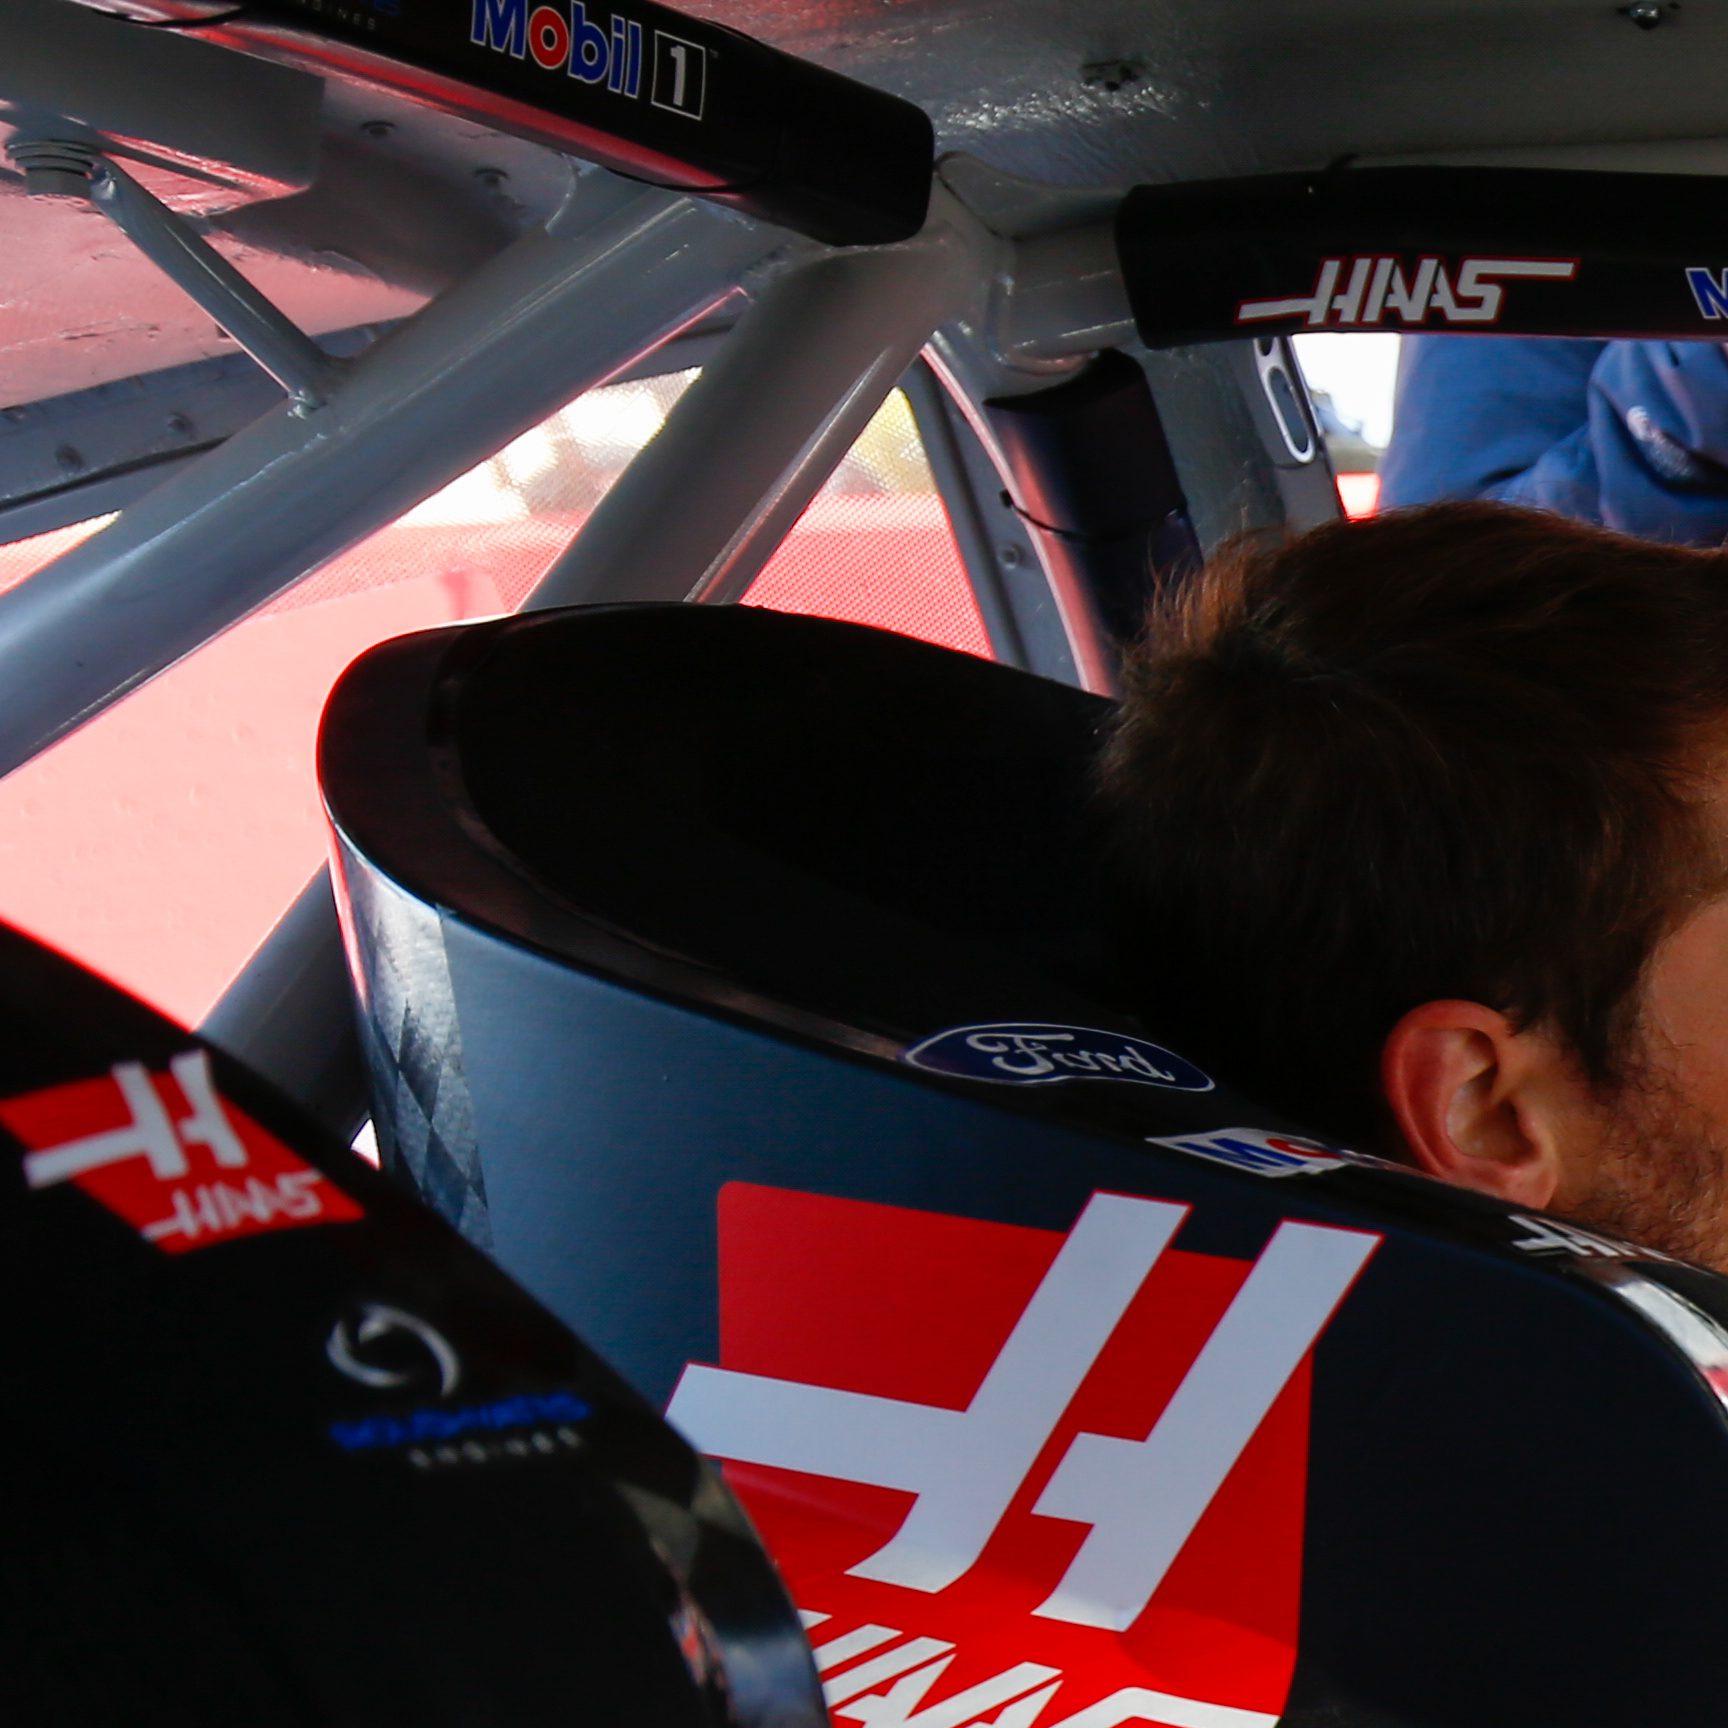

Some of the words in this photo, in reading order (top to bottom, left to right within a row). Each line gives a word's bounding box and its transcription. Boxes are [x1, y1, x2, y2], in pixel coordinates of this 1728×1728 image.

[470, 0, 642, 99] Mobil
[1236, 256, 1577, 325] HAAS
[966, 1032, 1176, 1082] Ford
[140, 1167, 323, 1243] HAAS
